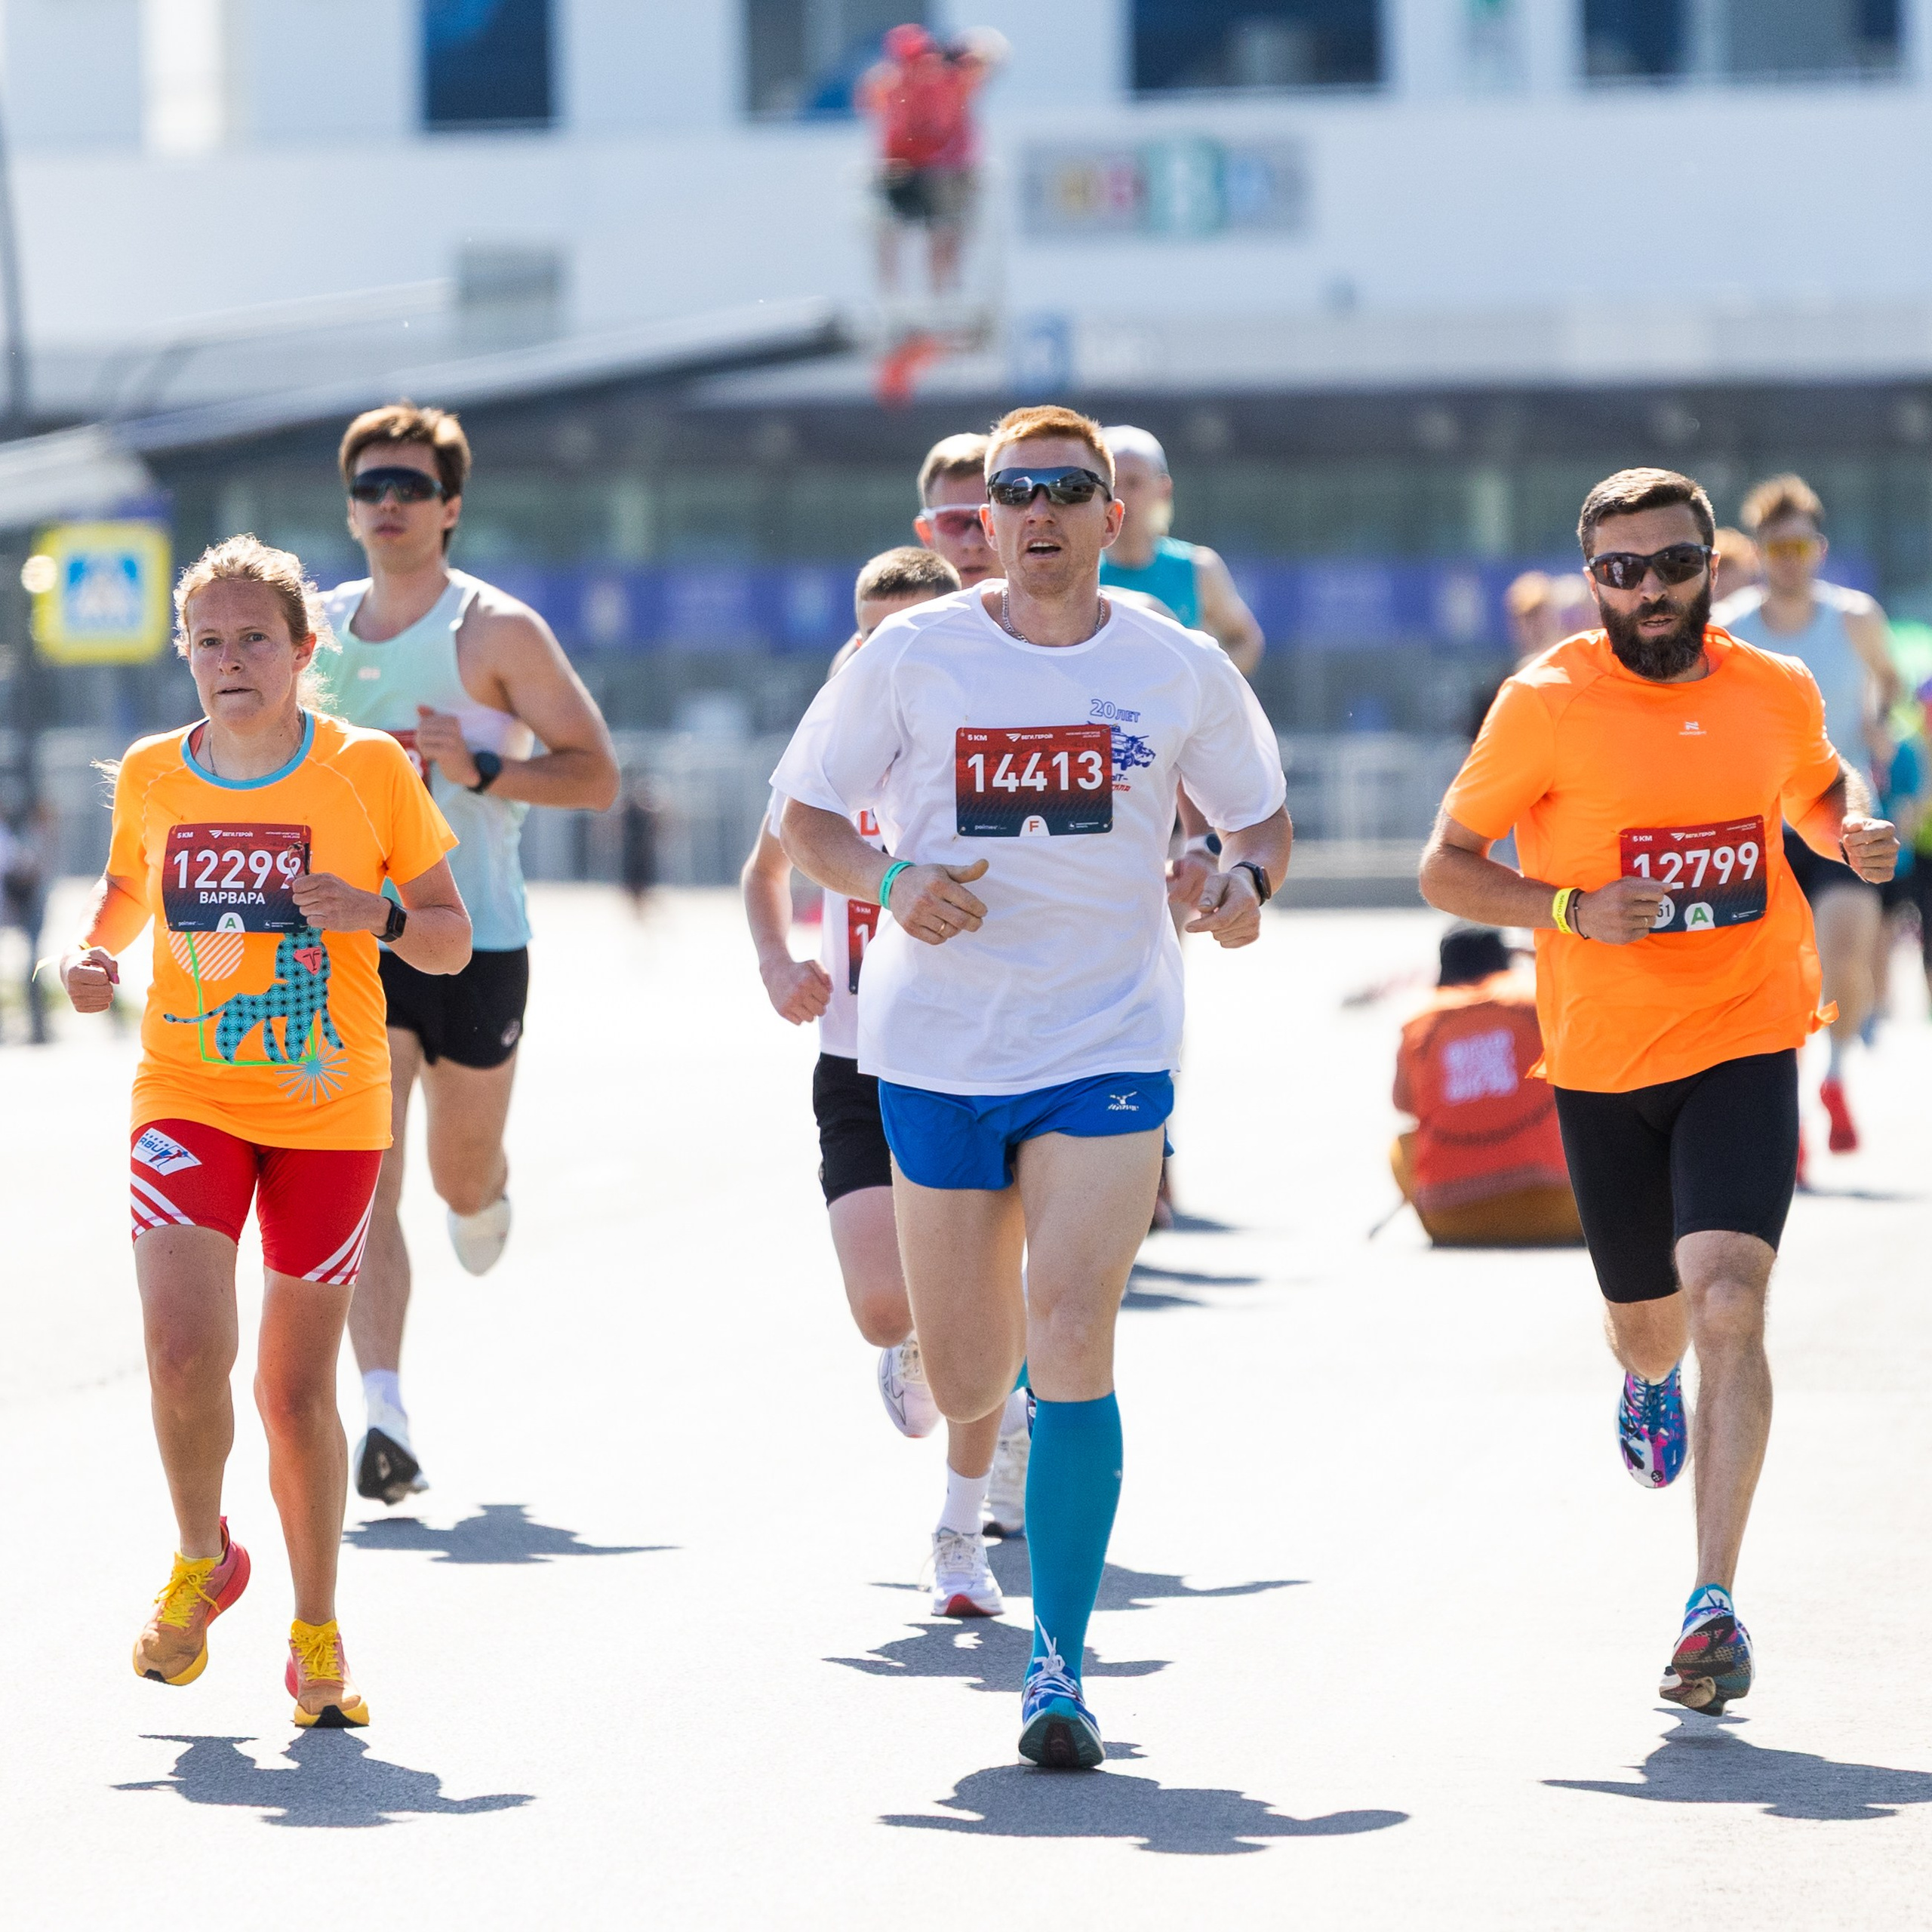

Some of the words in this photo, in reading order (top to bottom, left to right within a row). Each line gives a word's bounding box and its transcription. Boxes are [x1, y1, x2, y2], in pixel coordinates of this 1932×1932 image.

[1089, 698, 1116, 718] 20
[1115, 709, 1141, 723] ЛЕТ
[968, 750, 1103, 792] 14413
[1029, 820, 1039, 832] F
[174, 849, 301, 889] 12299
[1633, 841, 1759, 890] 12799
[199, 891, 266, 904] ВАРВАРА
[225, 918, 236, 929] A
[1690, 906, 1709, 926] A
